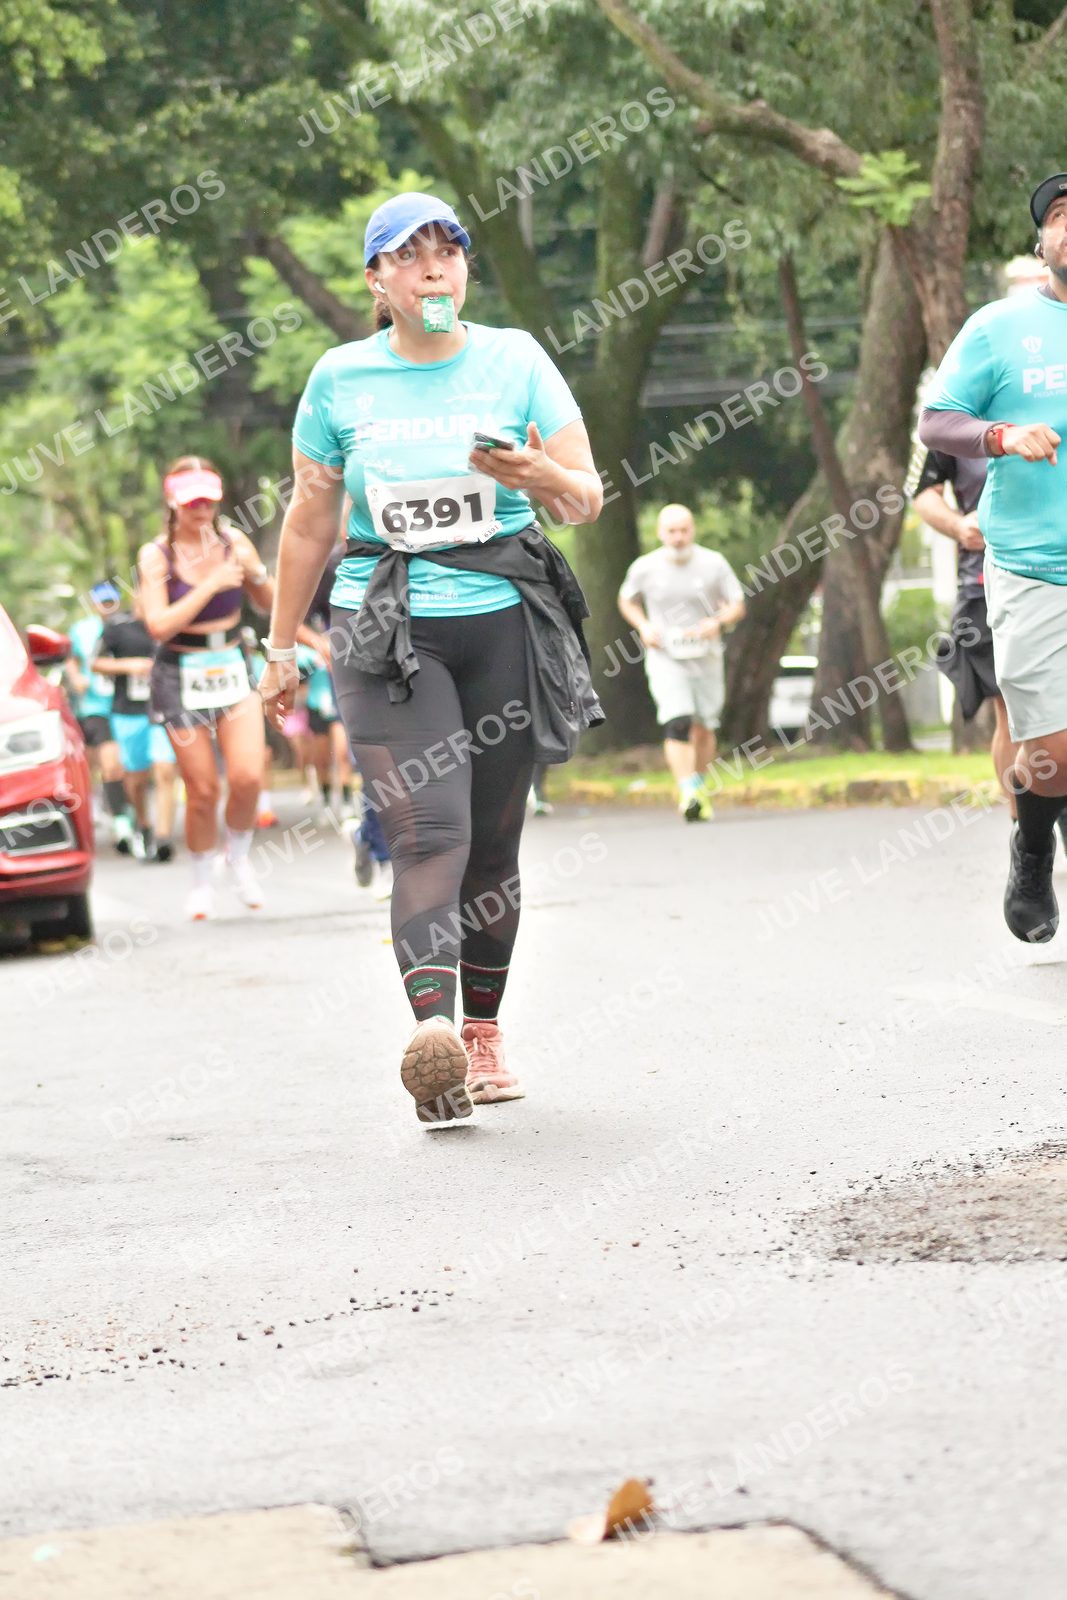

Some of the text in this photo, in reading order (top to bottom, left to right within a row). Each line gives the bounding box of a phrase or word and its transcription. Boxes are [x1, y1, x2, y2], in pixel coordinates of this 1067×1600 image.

[1022, 363, 1067, 394] PE
[381, 491, 484, 534] 6391
[483, 525, 500, 538] 6391
